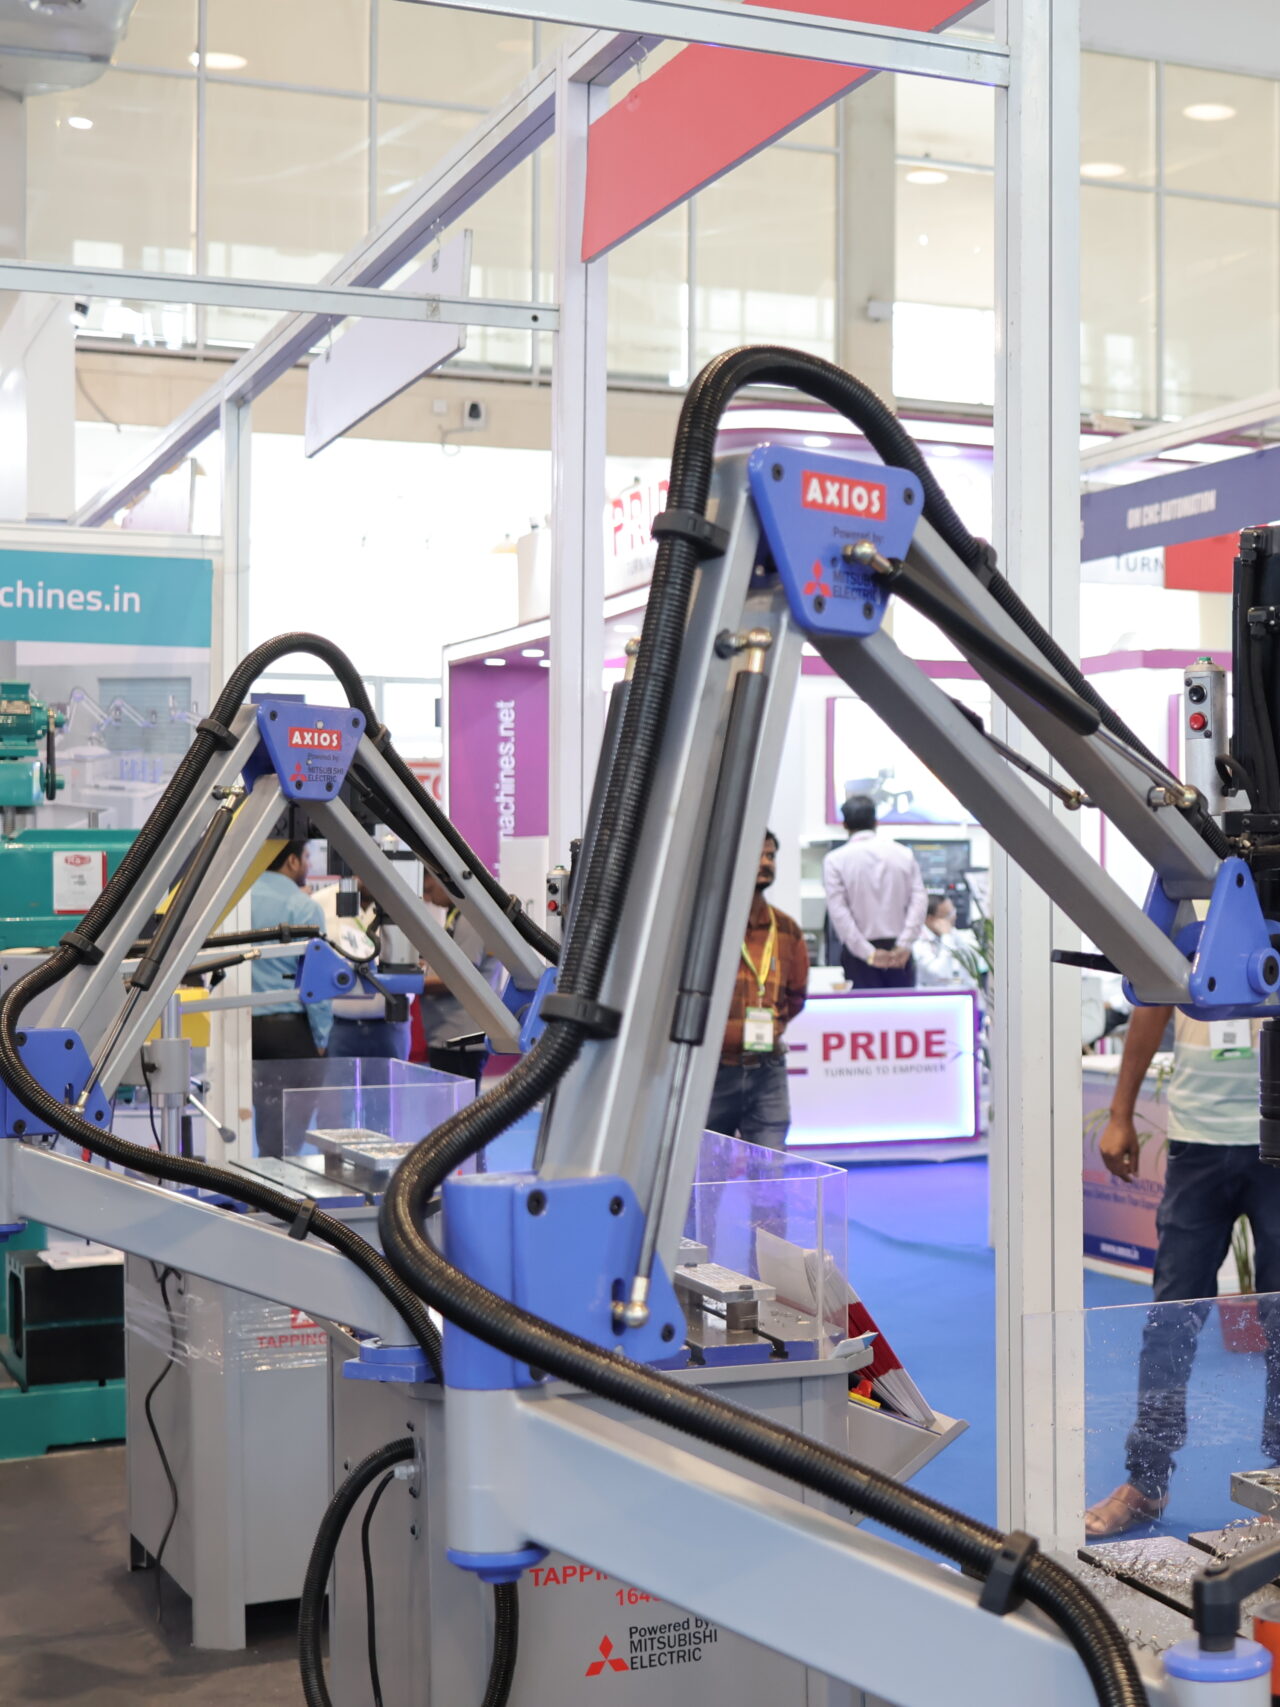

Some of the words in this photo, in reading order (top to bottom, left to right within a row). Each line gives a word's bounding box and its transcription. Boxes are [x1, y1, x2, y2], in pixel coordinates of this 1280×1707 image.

[806, 477, 881, 514] AXIOS
[0, 580, 141, 613] chines.in
[291, 730, 338, 747] AXIOS
[822, 1029, 946, 1062] PRIDE
[824, 1067, 872, 1078] TURNING
[876, 1065, 889, 1076] TO
[893, 1064, 946, 1076] EMPOWER
[629, 1617, 690, 1640] Powered
[630, 1628, 718, 1654] MITSUBISHI
[630, 1647, 702, 1671] ELECTRIC
